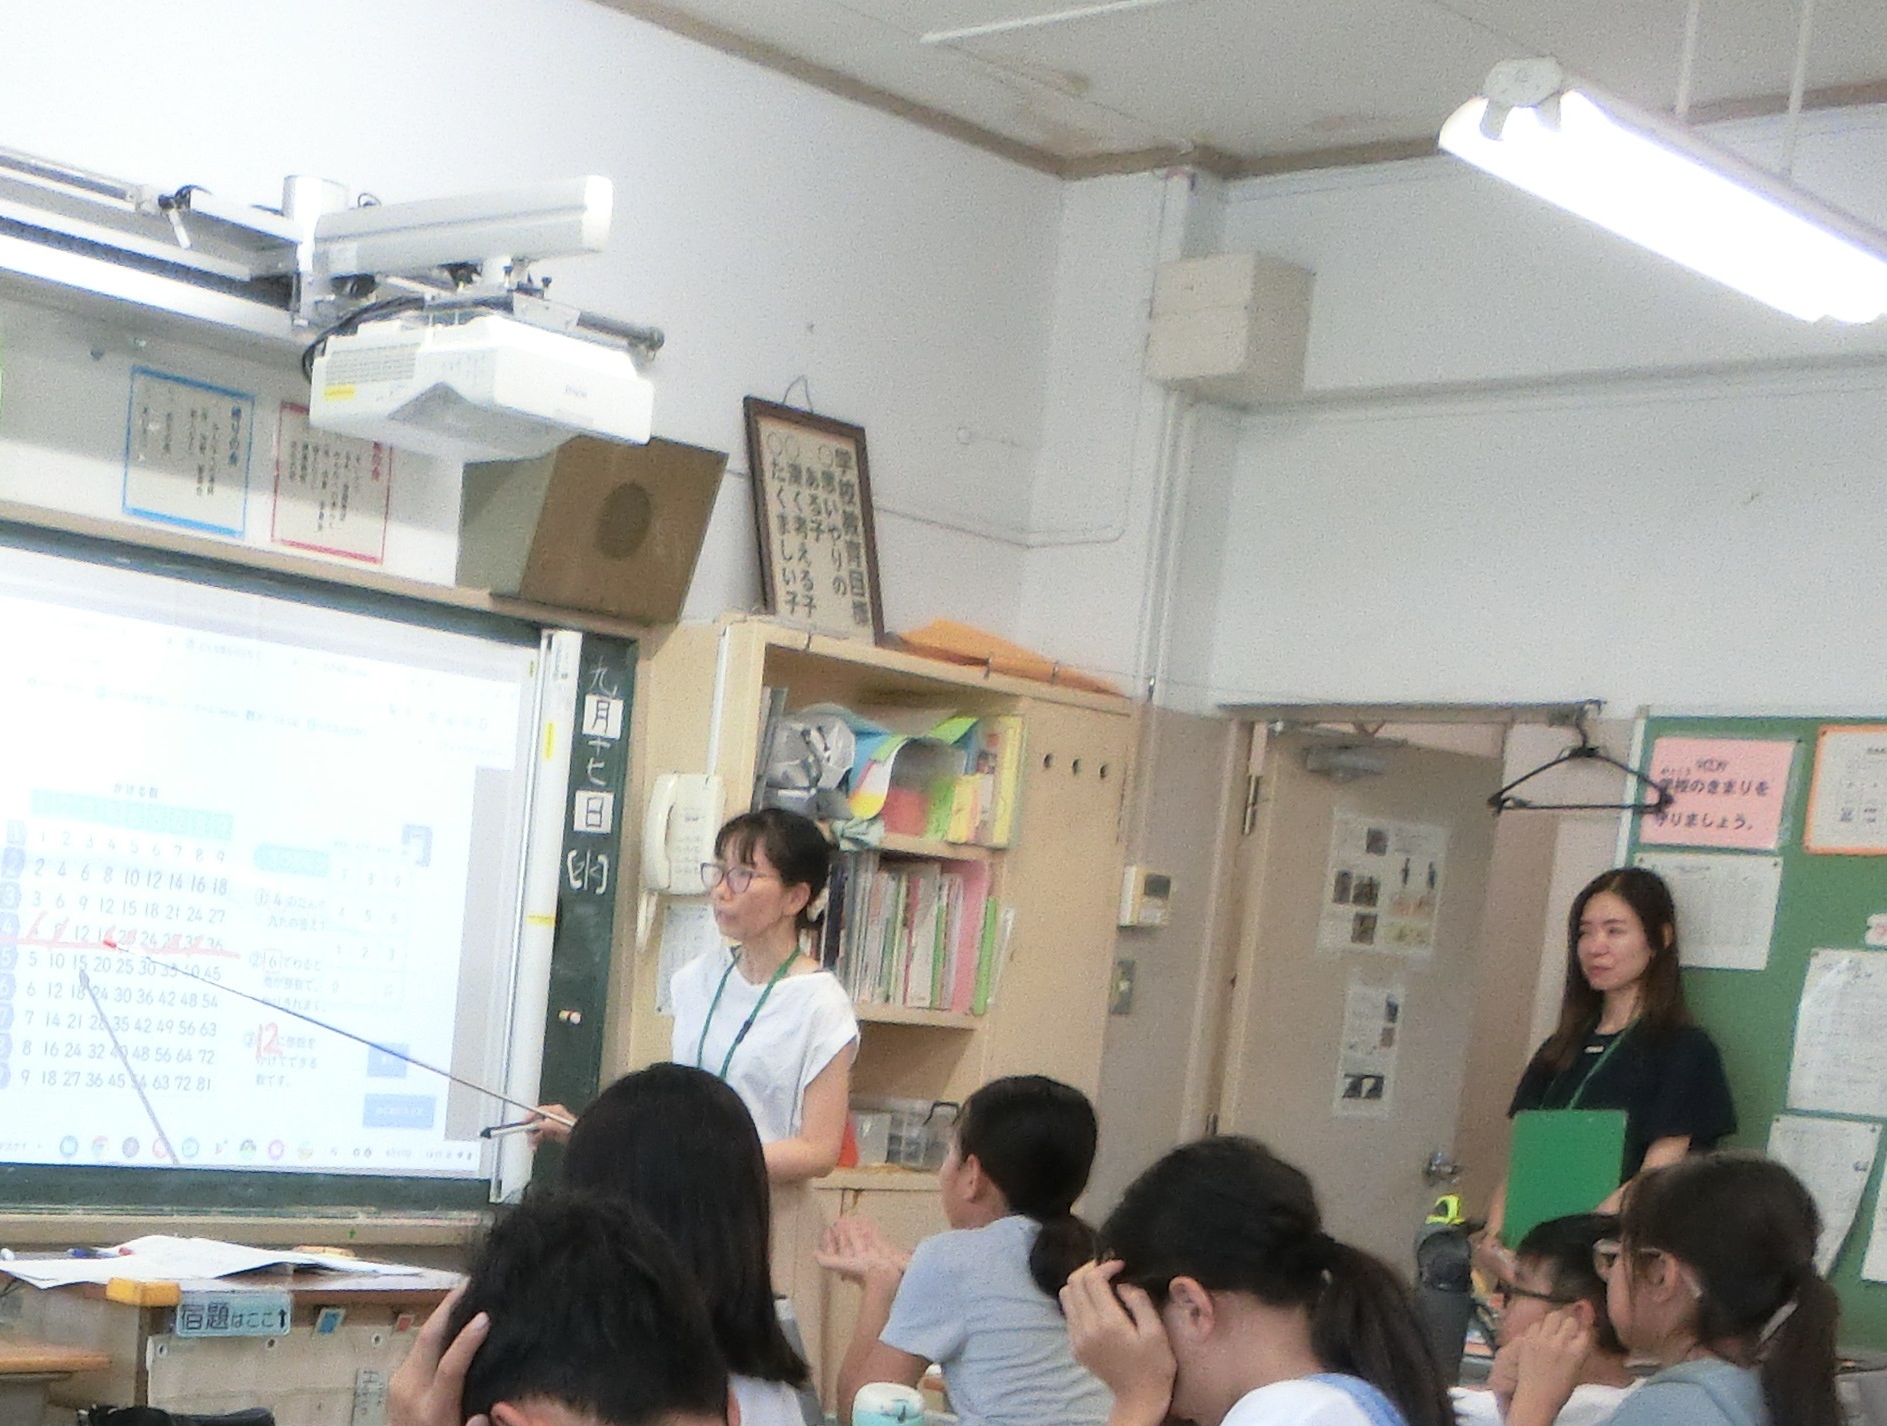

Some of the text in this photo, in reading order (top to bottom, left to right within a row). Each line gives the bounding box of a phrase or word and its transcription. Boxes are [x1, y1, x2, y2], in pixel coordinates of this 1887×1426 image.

[34, 858, 45, 876] 2
[57, 861, 67, 878] 4
[81, 864, 90, 881] 6
[103, 866, 113, 882] 8
[124, 868, 139, 887] 10
[146, 870, 162, 889] 12
[169, 873, 183, 891] 14
[191, 875, 205, 893] 16
[213, 878, 228, 896] 18
[32, 890, 41, 907] 3
[56, 893, 65, 909] 6
[79, 896, 88, 911] 9
[99, 898, 114, 914] 12
[122, 900, 137, 916] 15
[145, 902, 158, 918] 18
[165, 904, 180, 920] 21
[187, 906, 203, 922] 24
[208, 909, 225, 924] 27
[75, 925, 90, 941] 12
[141, 930, 157, 948] 24
[29, 951, 38, 967] 5
[50, 953, 65, 969] 10
[73, 954, 87, 971] 15
[94, 957, 111, 972] 20
[116, 958, 134, 974] 25
[138, 958, 156, 976] 30
[205, 965, 221, 981] 45
[27, 981, 36, 996] 6
[48, 983, 62, 999] 12
[71, 984, 86, 1000] 18
[114, 987, 131, 1002] 30
[139, 988, 154, 1005] 36
[158, 991, 176, 1006] 42
[180, 993, 197, 1008] 48
[201, 994, 218, 1008] 54
[25, 1010, 34, 1025] 7
[46, 1012, 61, 1027] 14
[68, 1014, 82, 1029] 21
[113, 1016, 130, 1032] 35
[134, 1018, 151, 1033] 42
[157, 1019, 173, 1034] 49
[178, 1020, 195, 1035] 56
[199, 1021, 217, 1036] 63
[23, 1040, 32, 1055] 8
[44, 1041, 59, 1057] 16
[65, 1043, 81, 1058] 24
[89, 1044, 105, 1060] 32
[133, 1045, 150, 1061] 48
[155, 1046, 171, 1061] 56
[176, 1047, 193, 1062] 64
[198, 1049, 214, 1064] 72
[21, 1069, 30, 1084] 9
[42, 1070, 56, 1086] 18
[64, 1071, 80, 1086] 27
[85, 1072, 103, 1087] 36
[109, 1072, 125, 1088] 45
[152, 1074, 169, 1090] 63
[174, 1075, 191, 1091] 72
[196, 1075, 211, 1091] 81
[181, 1302, 274, 1330] 宿題はここ
